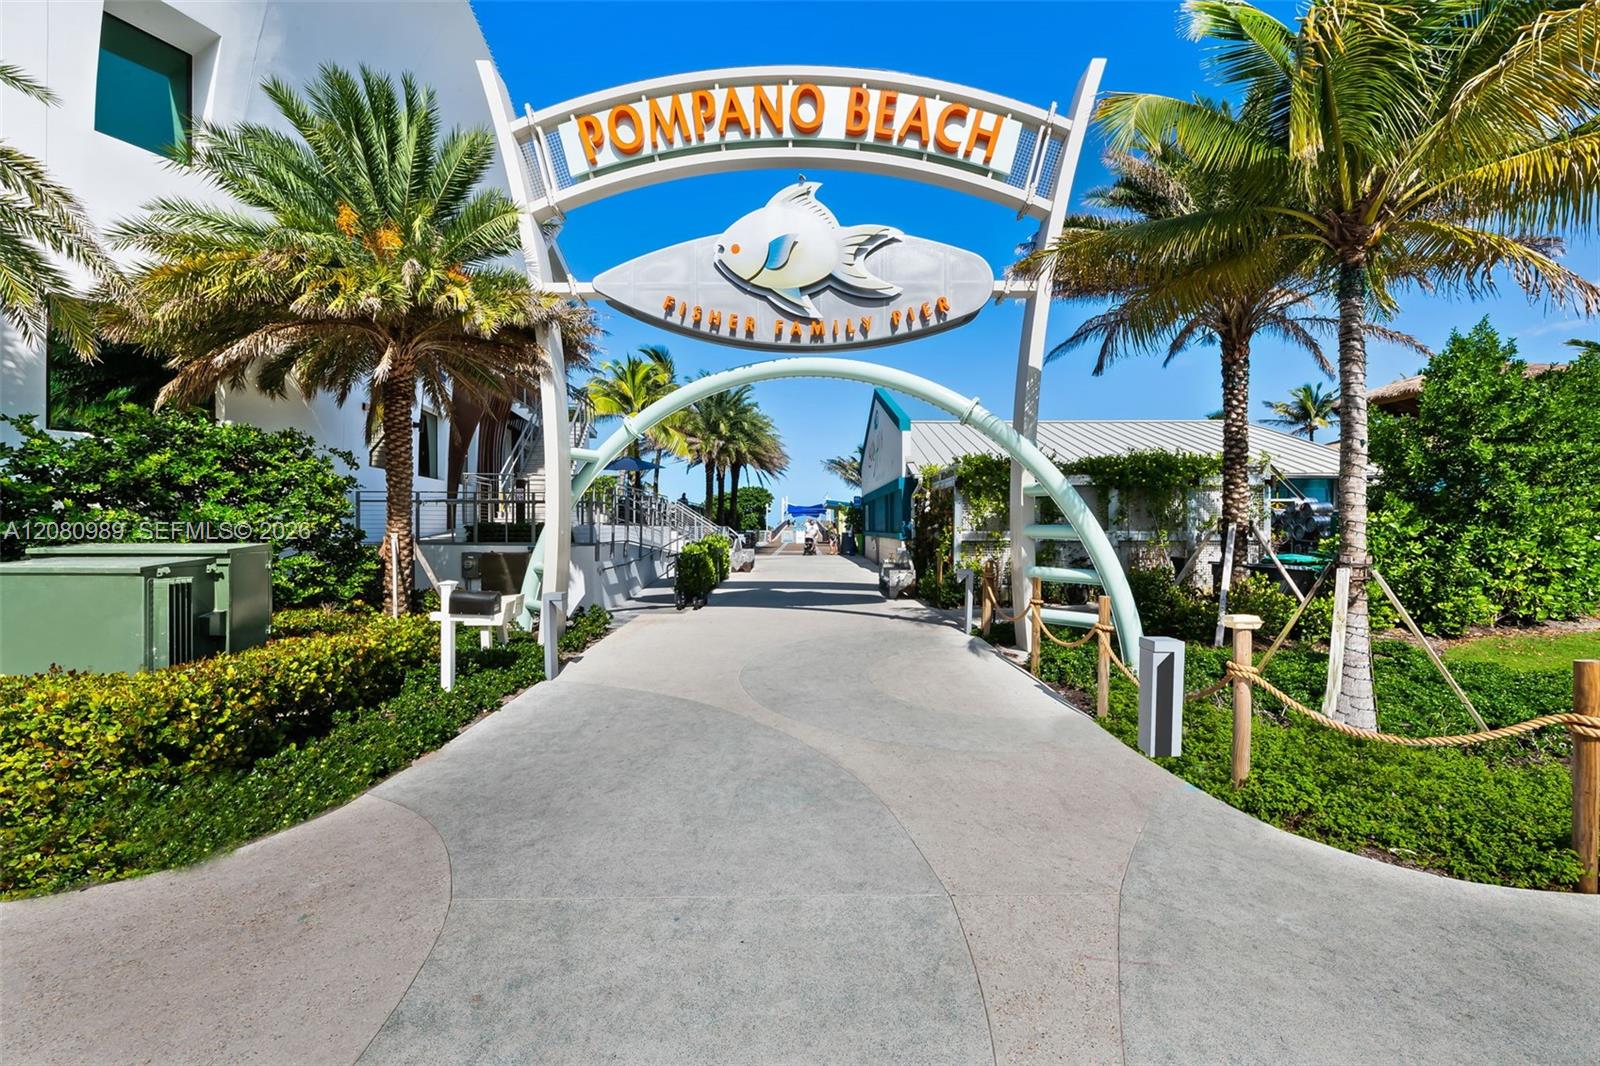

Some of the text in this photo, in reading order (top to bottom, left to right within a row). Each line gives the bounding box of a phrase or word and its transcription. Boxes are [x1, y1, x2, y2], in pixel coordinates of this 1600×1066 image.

[577, 83, 1004, 165] POMPANO BEACH
[662, 296, 951, 337] FISHER FAMILY PIER
